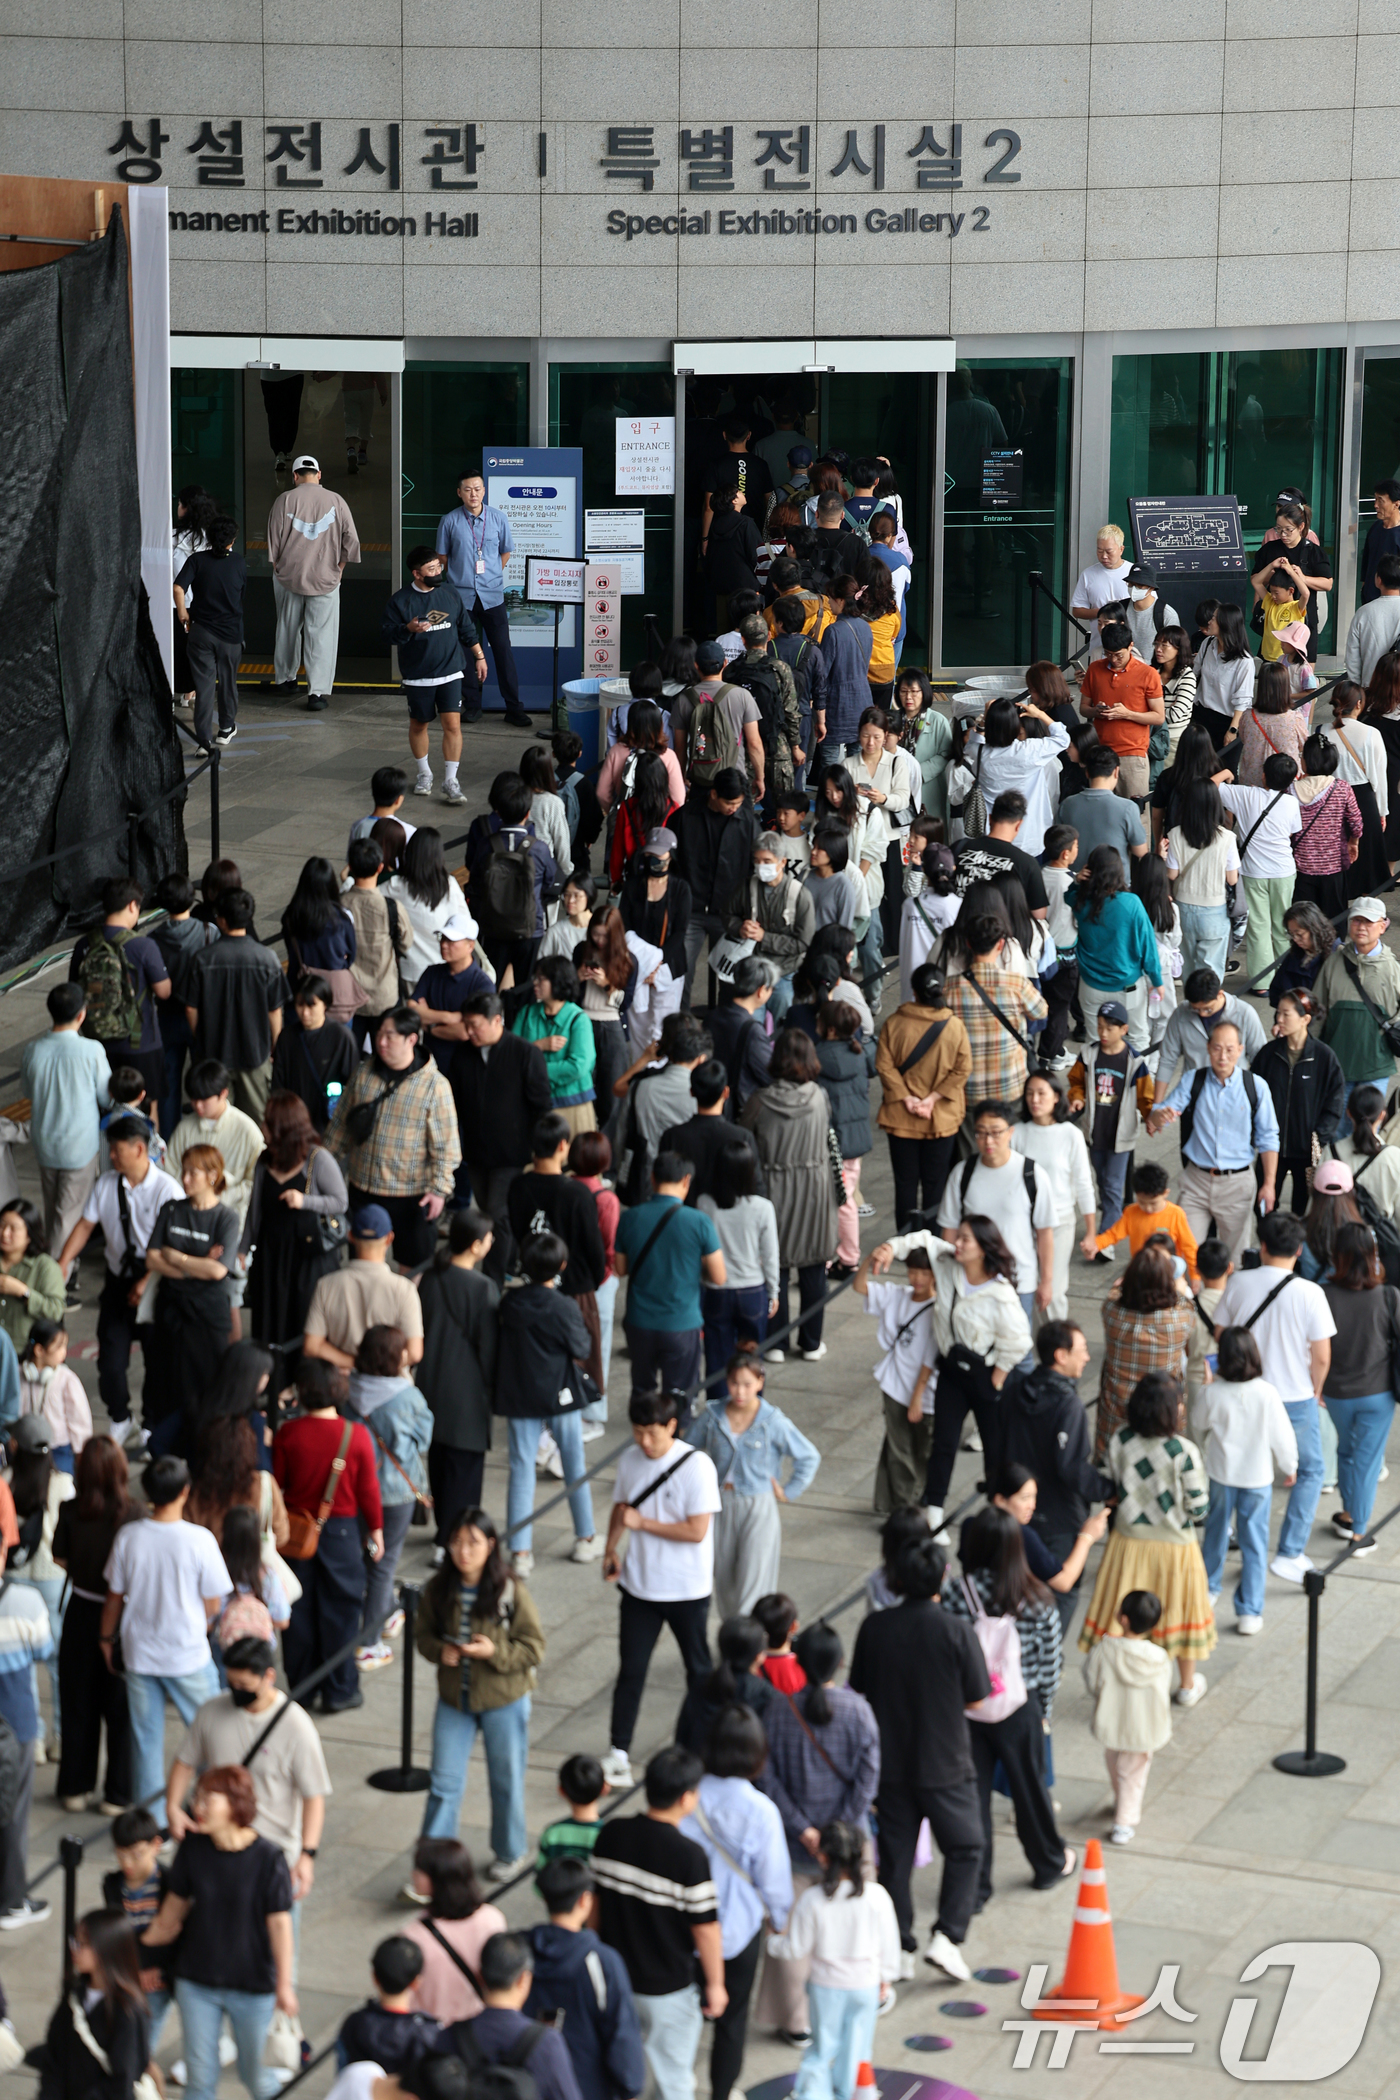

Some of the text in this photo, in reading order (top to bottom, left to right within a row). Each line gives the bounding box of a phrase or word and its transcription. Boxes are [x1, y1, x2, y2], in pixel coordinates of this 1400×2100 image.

[108, 118, 485, 190] 상설전시관
[277, 209, 417, 236] Exhibition
[425, 212, 479, 237] Hall
[607, 206, 991, 240] Special Exhibition Gallery 2
[621, 442, 671, 451] ENTRANCE
[659, 465, 671, 473] 다시
[521, 488, 543, 497] 안내문
[536, 568, 582, 578] 가방 미소지자
[554, 579, 579, 587] 입장통로
